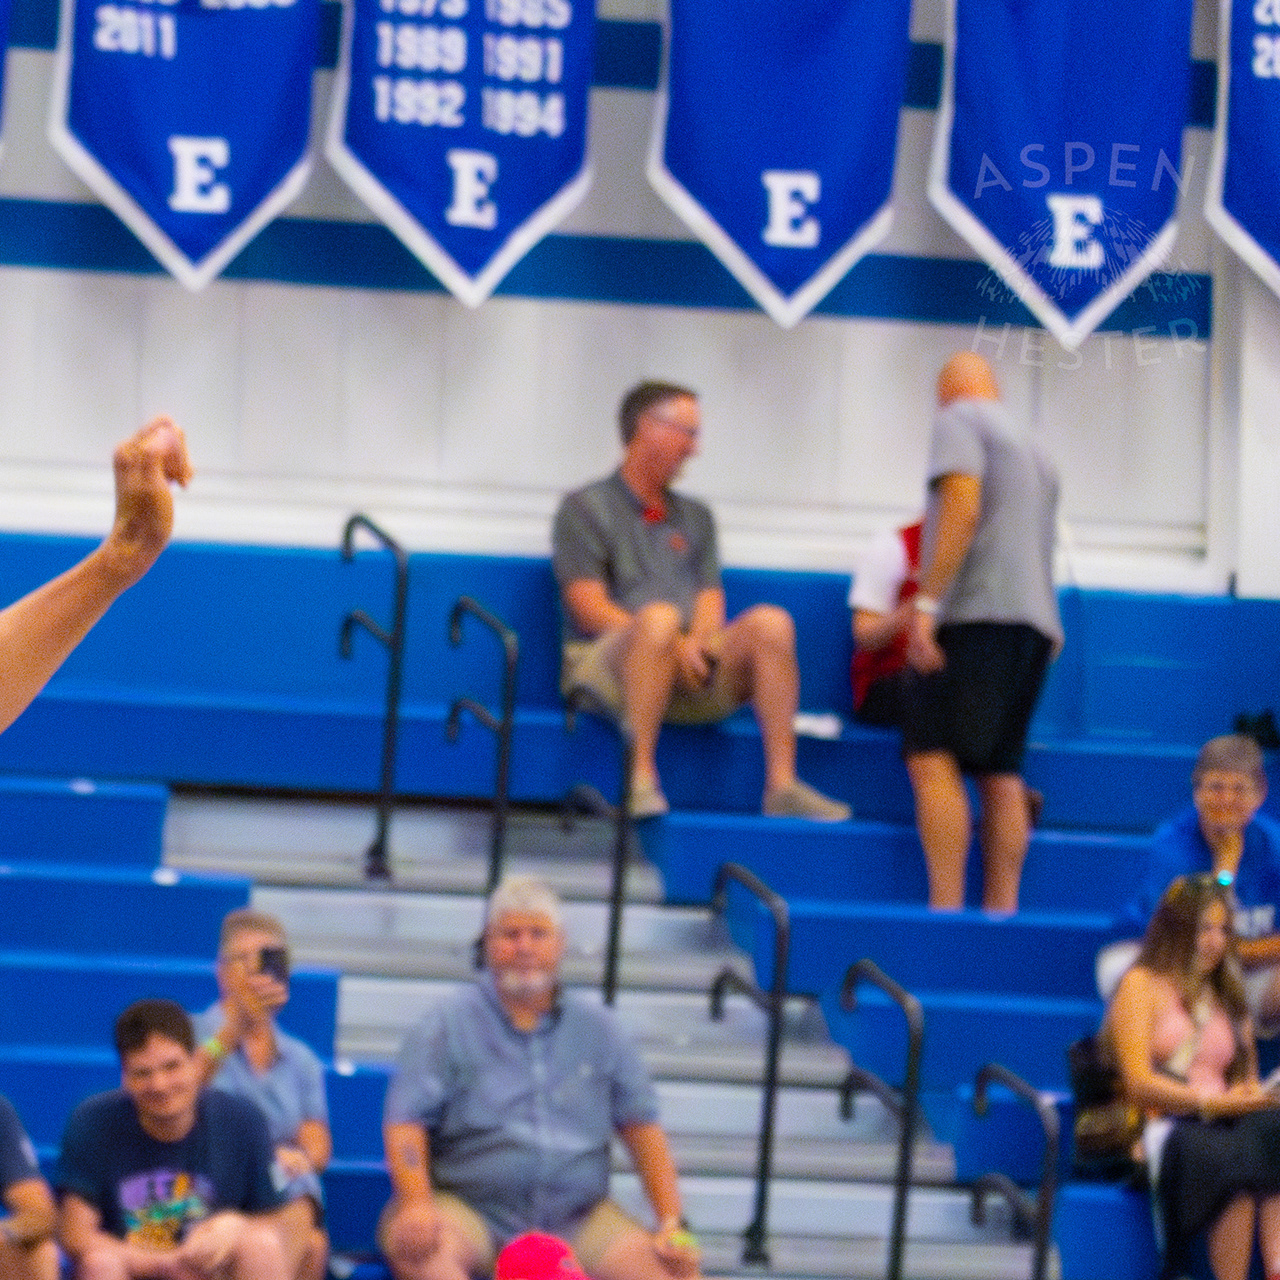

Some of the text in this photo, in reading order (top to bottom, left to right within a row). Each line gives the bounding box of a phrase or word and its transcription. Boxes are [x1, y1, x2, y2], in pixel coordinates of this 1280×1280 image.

[168, 137, 231, 214] E
[446, 149, 498, 229] E
[762, 171, 821, 248] E
[1046, 194, 1106, 270] E
